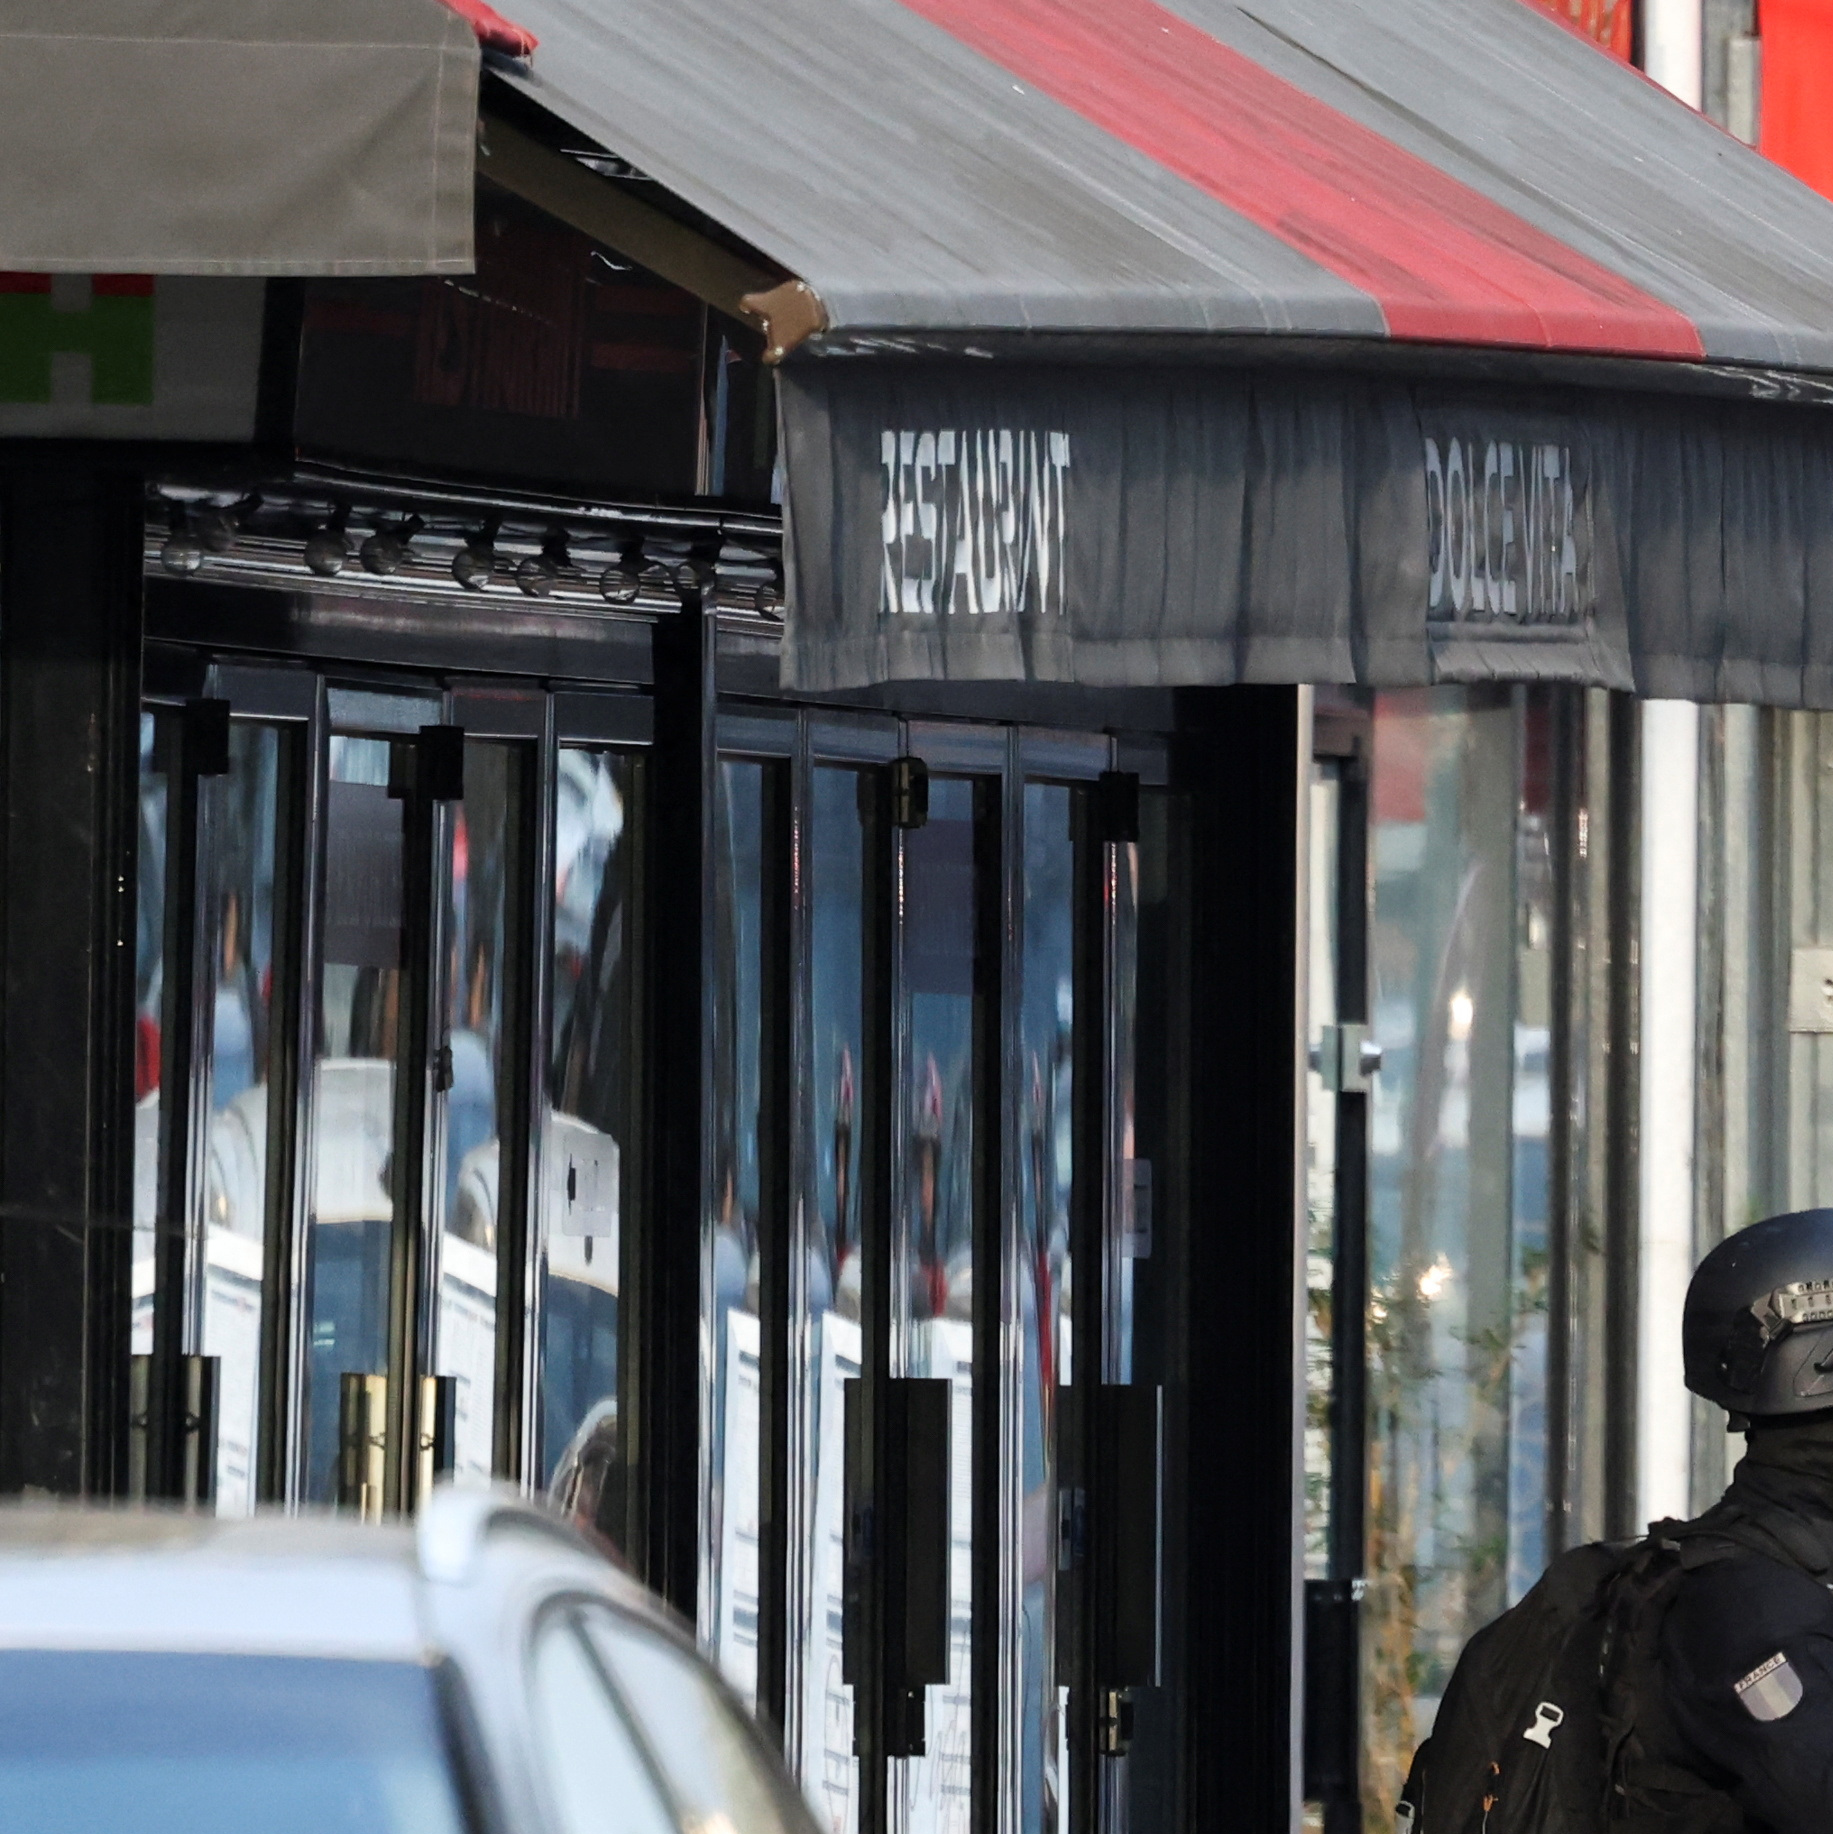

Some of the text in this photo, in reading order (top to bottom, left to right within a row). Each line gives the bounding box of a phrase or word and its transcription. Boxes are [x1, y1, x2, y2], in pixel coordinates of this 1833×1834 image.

[1424, 437, 1581, 615] DOLCE VITA
[1738, 1655, 1784, 1692] FRANCE
